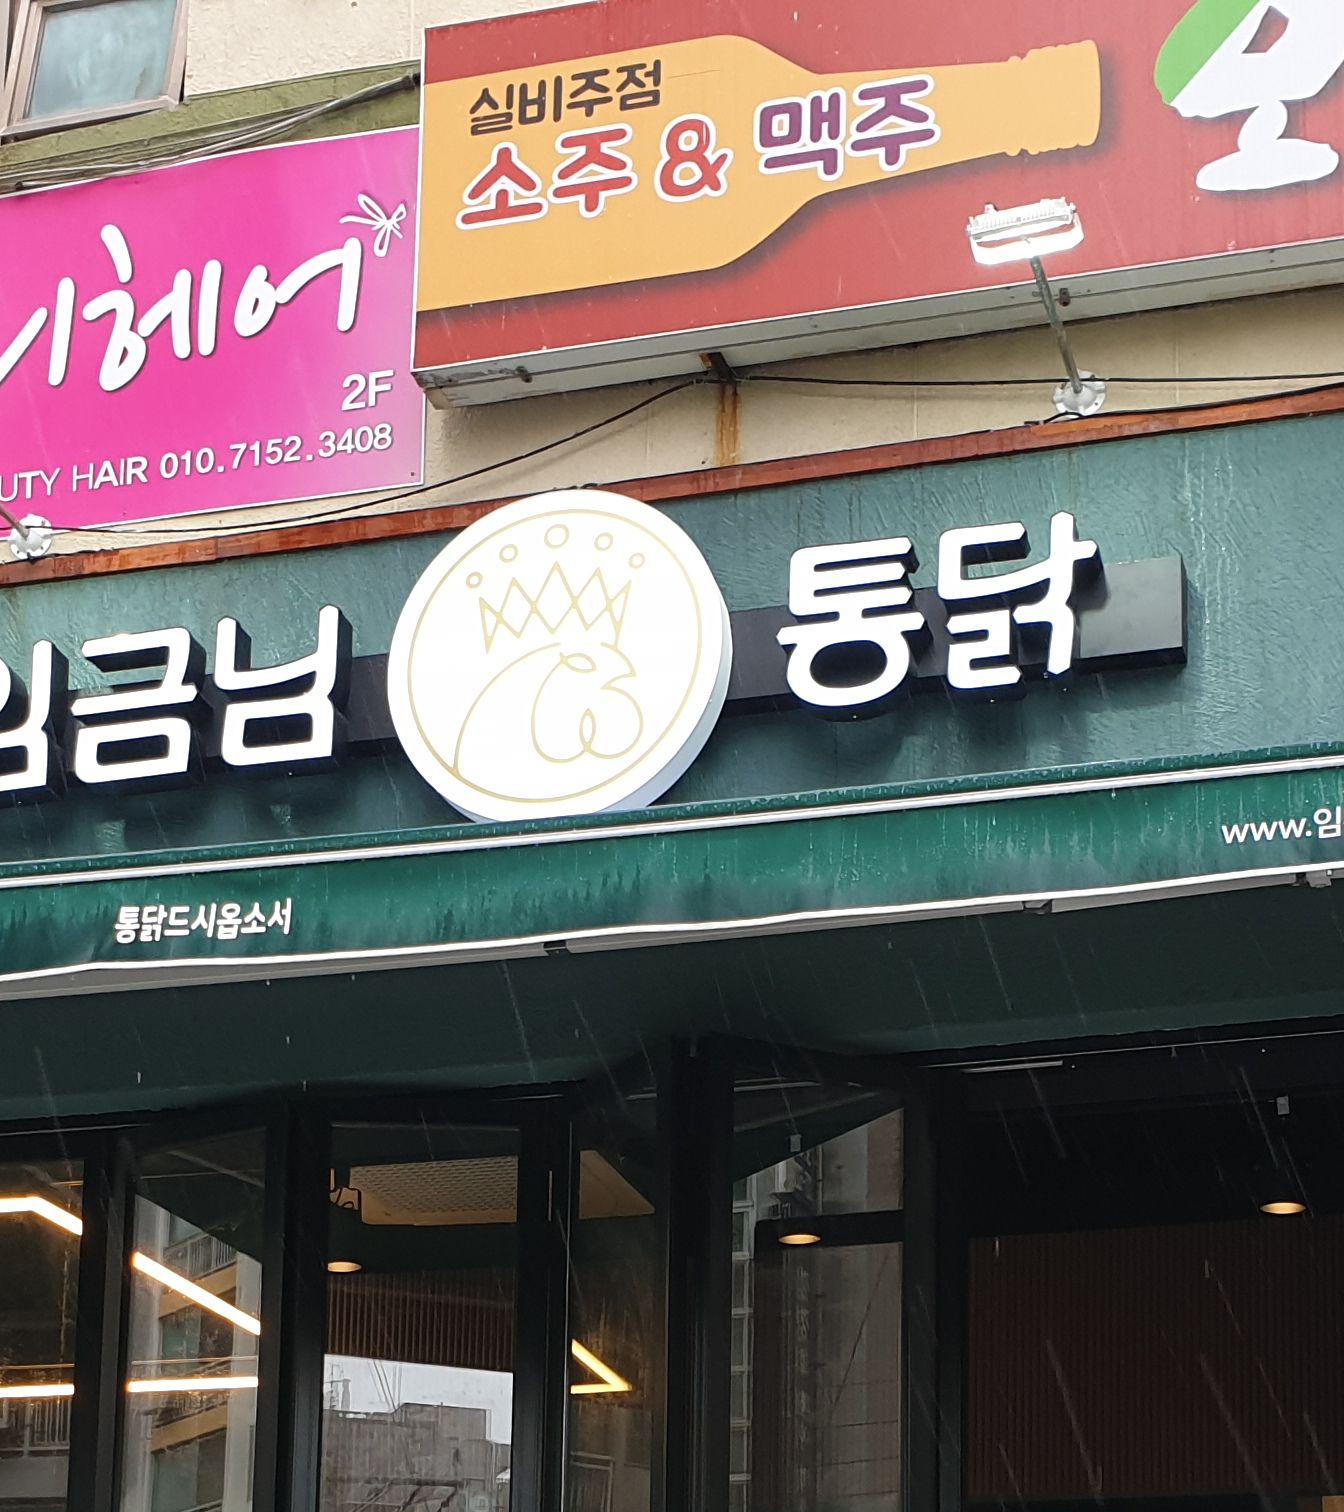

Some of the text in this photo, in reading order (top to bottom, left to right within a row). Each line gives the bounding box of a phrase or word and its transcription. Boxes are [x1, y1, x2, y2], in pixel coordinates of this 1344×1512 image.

[468, 59, 662, 137] 실비주점
[455, 73, 941, 230] 소주 & 맥주
[340, 369, 395, 412] 2F
[72, 456, 149, 492] HAIR
[159, 423, 394, 479] 010.7152.3408
[777, 509, 1103, 708] 통닭
[114, 897, 292, 944] 통닭드시옵소서
